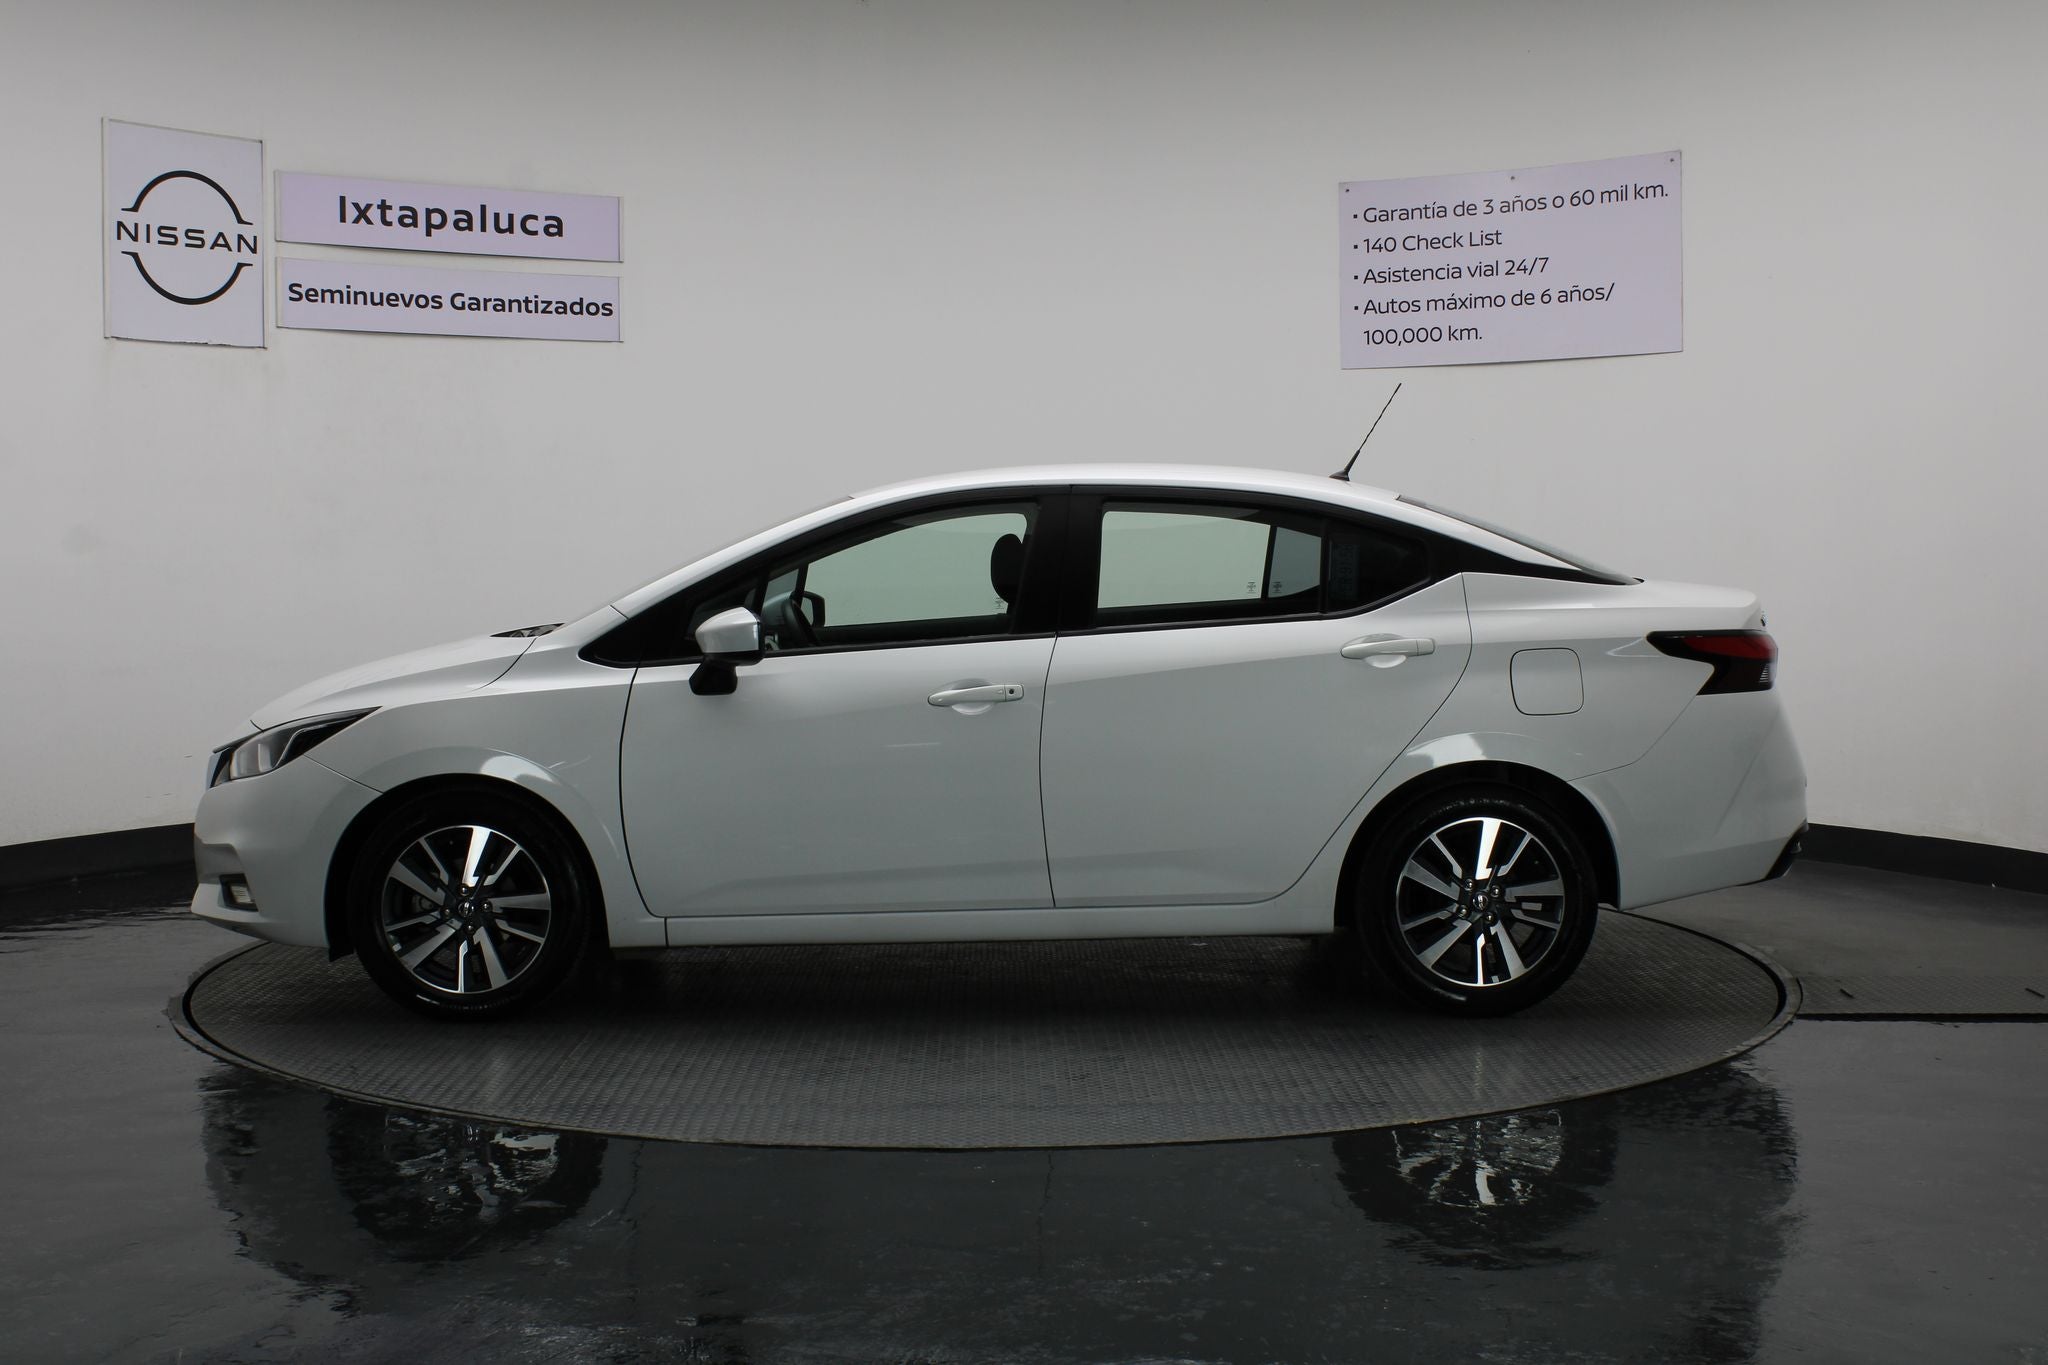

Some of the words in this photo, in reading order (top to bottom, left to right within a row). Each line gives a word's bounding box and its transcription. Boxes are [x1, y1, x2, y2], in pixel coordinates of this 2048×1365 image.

[339, 195, 564, 238] Ixtapaluca
[1363, 201, 1448, 223] Garantía
[1453, 200, 1478, 217] de
[1483, 199, 1495, 215] 3
[1499, 194, 1548, 214] años
[1552, 195, 1565, 209] o
[1569, 189, 1595, 207] 60
[1600, 184, 1628, 204] mil
[1634, 183, 1669, 201] km.
[116, 220, 258, 255] NISSAN
[1363, 236, 1397, 254] 140
[1402, 231, 1464, 252] Check
[1469, 229, 1503, 247] List
[1363, 266, 1462, 285] Asistencia
[1466, 259, 1499, 279] vial
[1504, 256, 1549, 276] 24/7
[288, 282, 444, 310] Seminuevos
[449, 292, 614, 317] Garantizados
[1363, 299, 1421, 315] Autos
[1426, 292, 1506, 312] máximo
[1510, 289, 1535, 307] de
[1540, 288, 1552, 305] 6
[1557, 282, 1615, 304] años/
[1363, 326, 1443, 347] 100,000
[1448, 325, 1483, 342] km.
